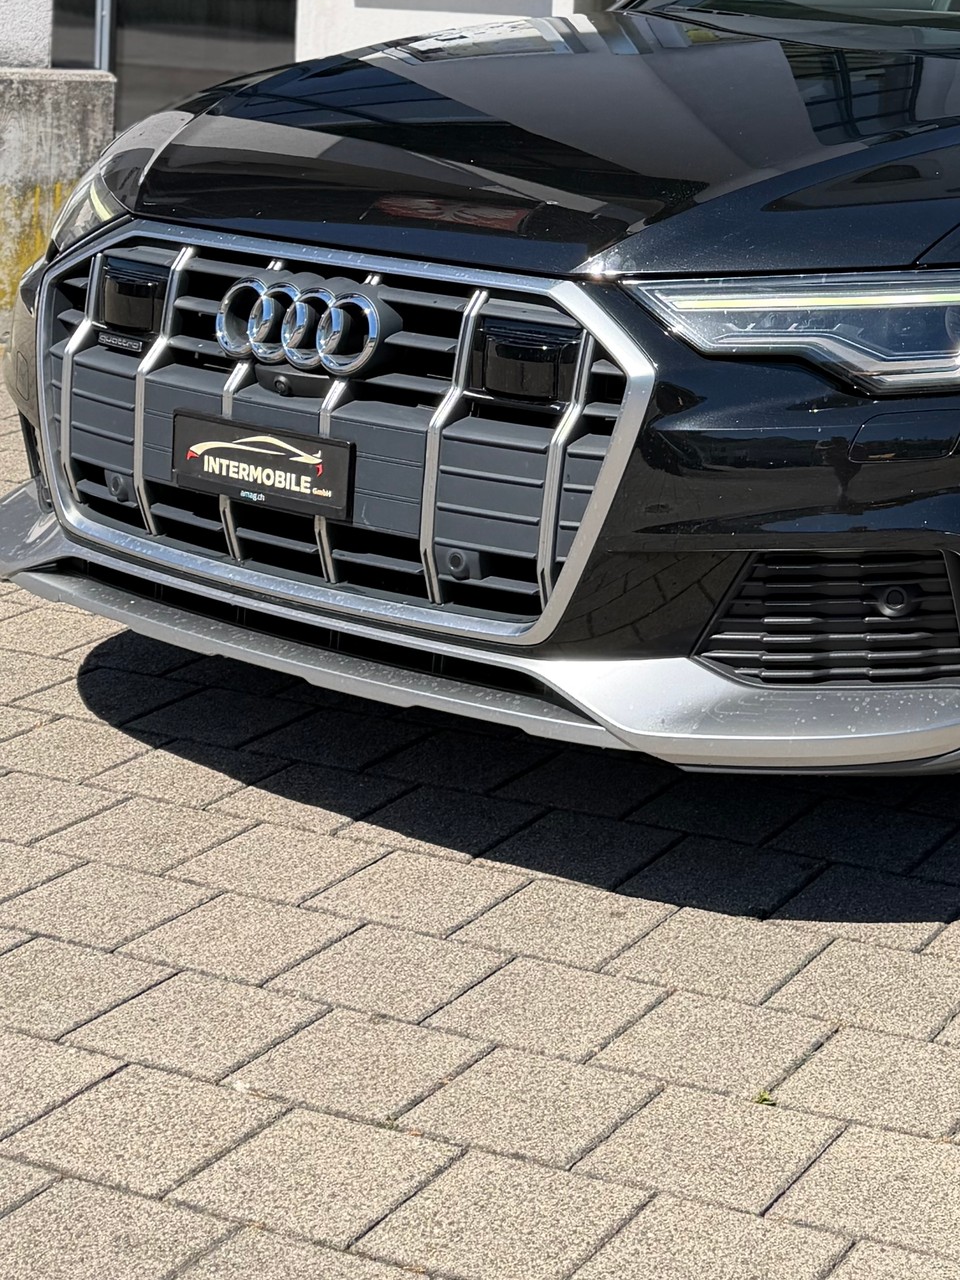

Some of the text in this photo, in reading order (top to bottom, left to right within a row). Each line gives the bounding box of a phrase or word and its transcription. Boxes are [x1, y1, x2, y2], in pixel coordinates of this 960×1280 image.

[98, 334, 139, 349] quattro
[204, 455, 332, 498] INTERMOBILE GmbH
[240, 489, 266, 502] amag.ch
